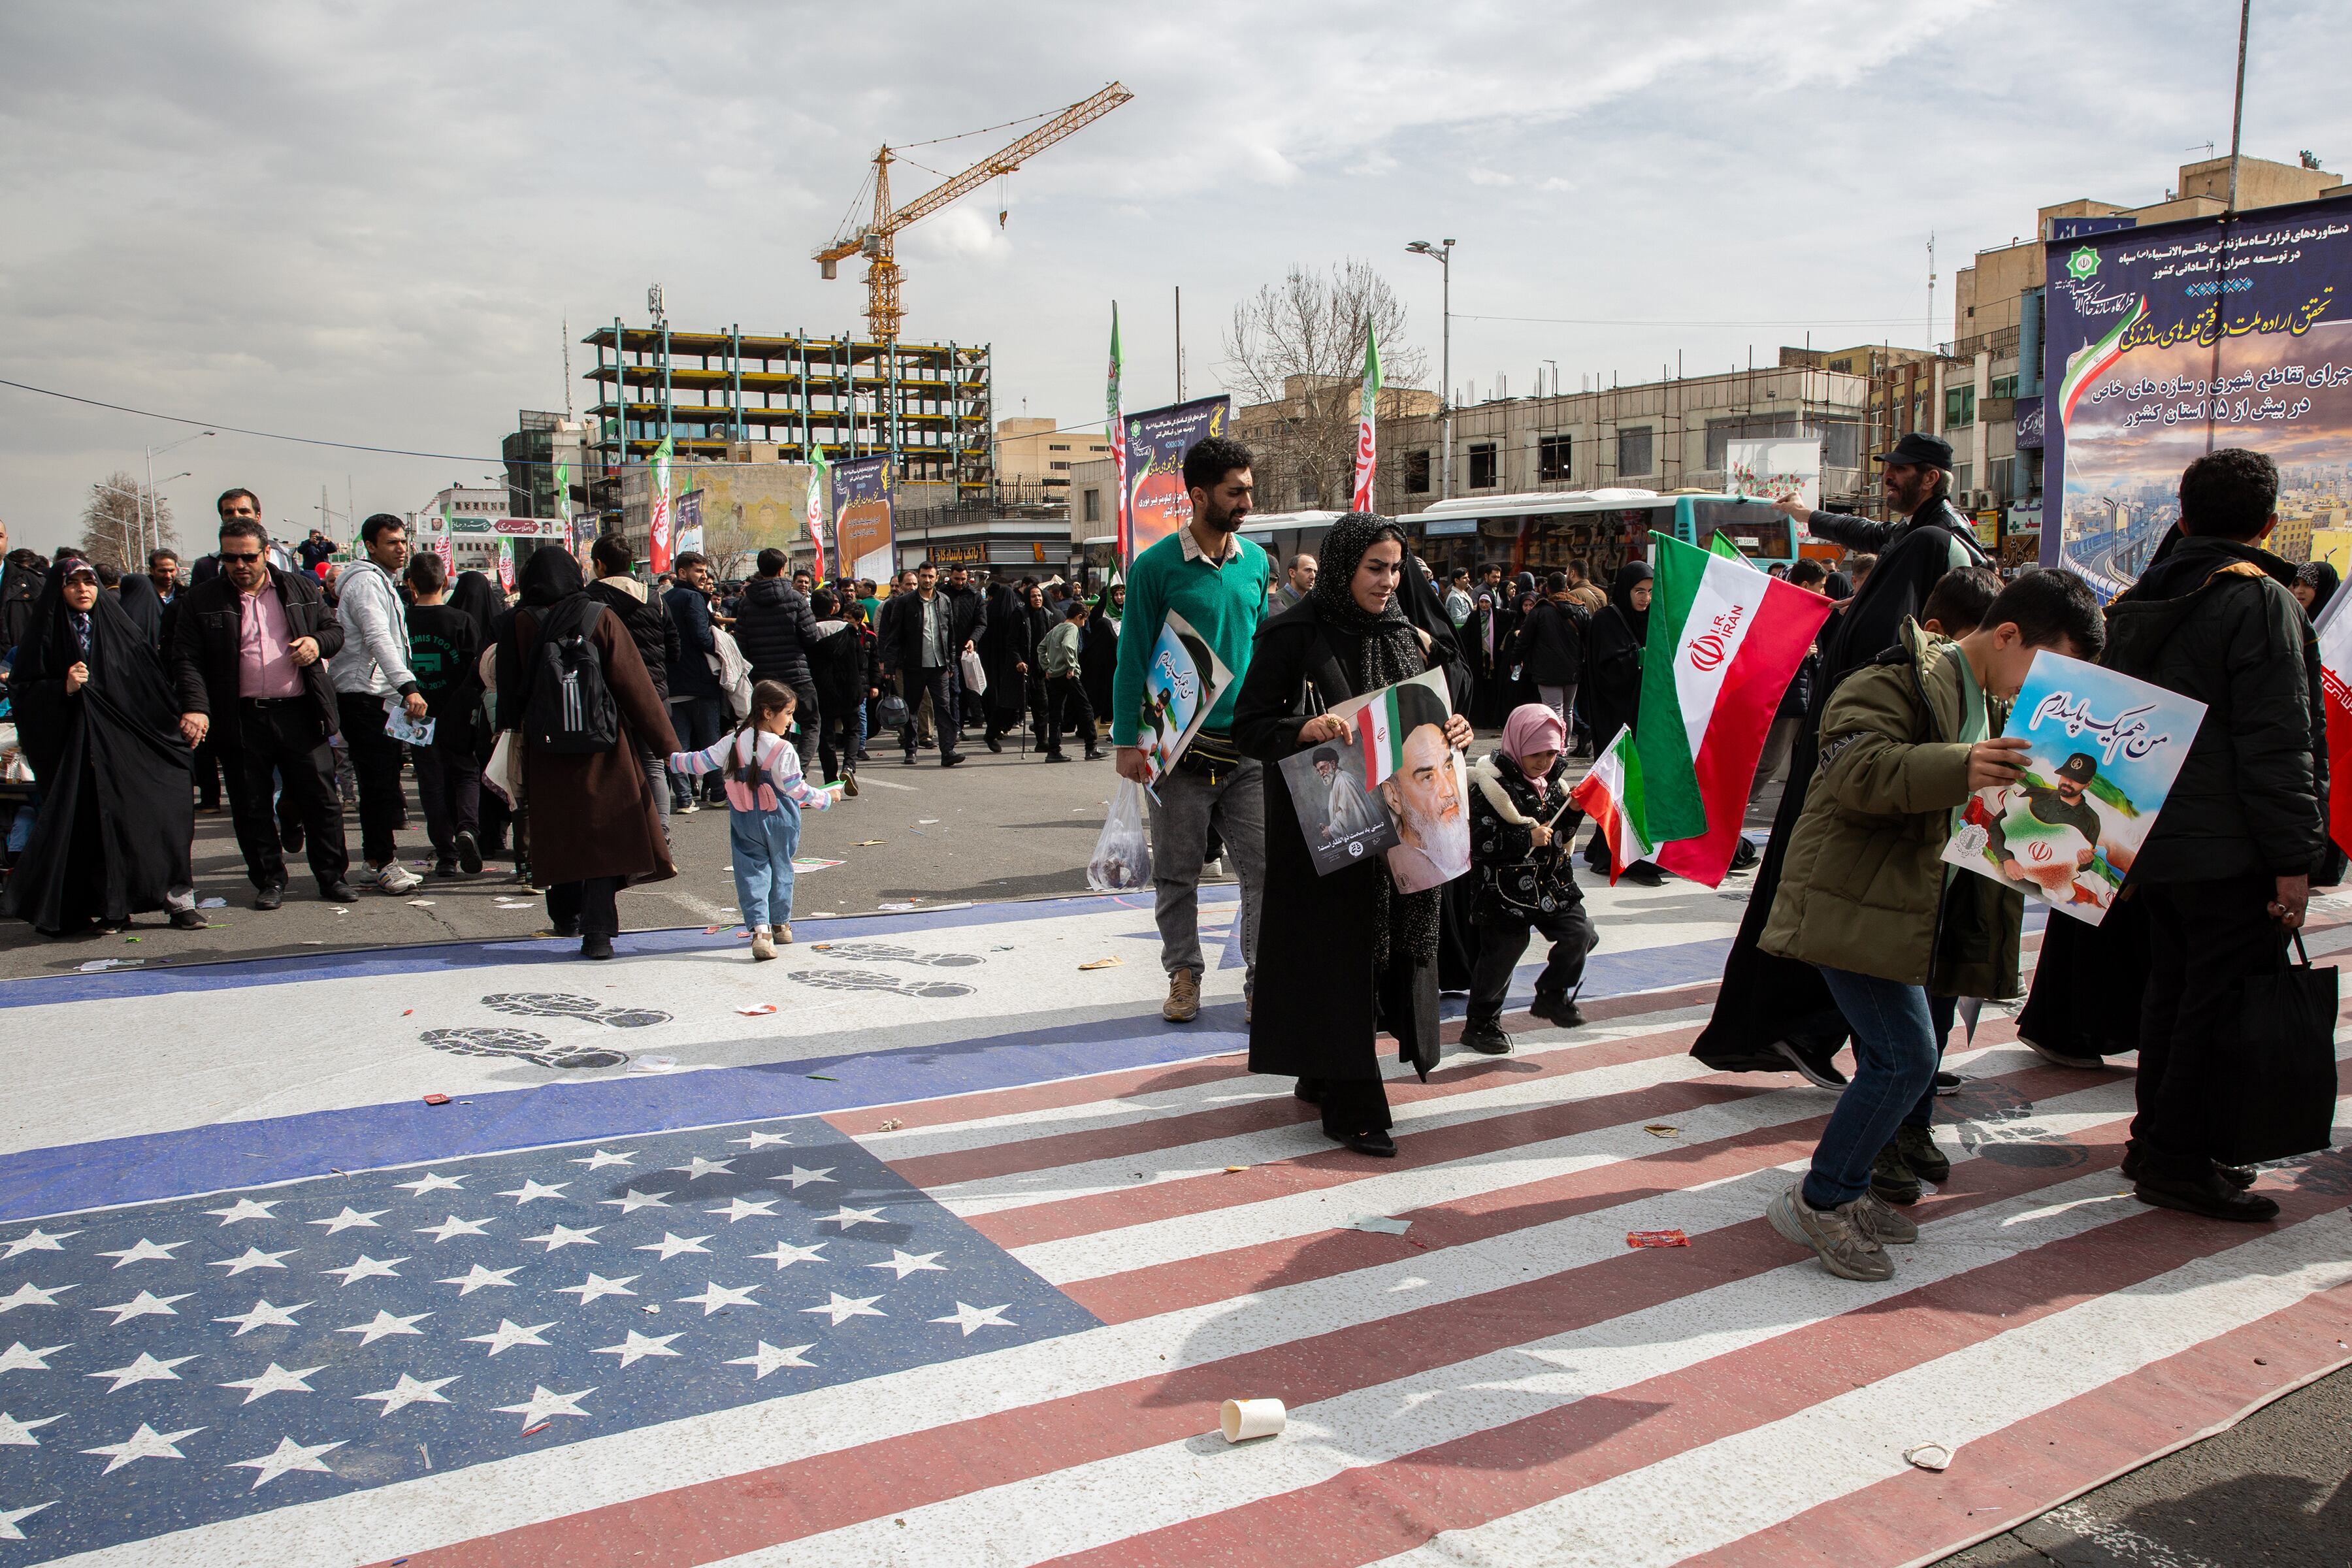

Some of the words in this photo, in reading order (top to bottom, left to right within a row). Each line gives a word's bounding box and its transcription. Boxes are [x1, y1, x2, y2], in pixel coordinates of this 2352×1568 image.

[2249, 230, 2290, 246] قرارگاه
[2291, 223, 2349, 243] دستاوردهای
[2181, 242, 2208, 257] خاتم
[2209, 237, 2248, 254] سازندگی
[2119, 253, 2136, 266] سپاه
[2176, 257, 2215, 277] آبادانی
[2222, 255, 2250, 270] عمران
[2253, 250, 2288, 264] توسعه
[2288, 250, 2301, 263] در
[2151, 264, 2175, 280] کشور
[2215, 263, 2221, 272] و
[2293, 286, 2334, 335] تحقق
[2121, 311, 2162, 350] سازندگی
[2229, 310, 2262, 335] ملت
[2261, 313, 2293, 332] اراده
[2208, 370, 2254, 395] شهری
[2256, 365, 2305, 393] تقاطع
[2306, 362, 2352, 389] جرای
[2092, 379, 2125, 403] خاص
[2127, 377, 2157, 400] های
[2159, 374, 2195, 399] سازه
[2195, 380, 2206, 397] و
[2123, 403, 2163, 428] کشور
[2163, 400, 2206, 425] استان
[2208, 398, 2229, 419] ۱۵
[2230, 397, 2249, 422] از
[2251, 397, 2286, 421] بیش
[2287, 397, 2311, 419] در
[1139, 495, 1150, 508] نوری
[1158, 493, 1172, 505] کیلومتر
[1173, 493, 1183, 504] هزار
[1163, 506, 1173, 518] کشور
[1186, 505, 1192, 515] در
[1710, 614, 1725, 634] I.R.
[1721, 605, 1743, 638] IRAN
[410, 634, 431, 645] EMIS
[433, 636, 451, 649] TOO
[449, 649, 460, 664] BIG
[2033, 694, 2086, 734] پاسدارم
[2084, 704, 2157, 743] یک
[2106, 722, 2145, 761] هم
[2126, 736, 2168, 759] من
